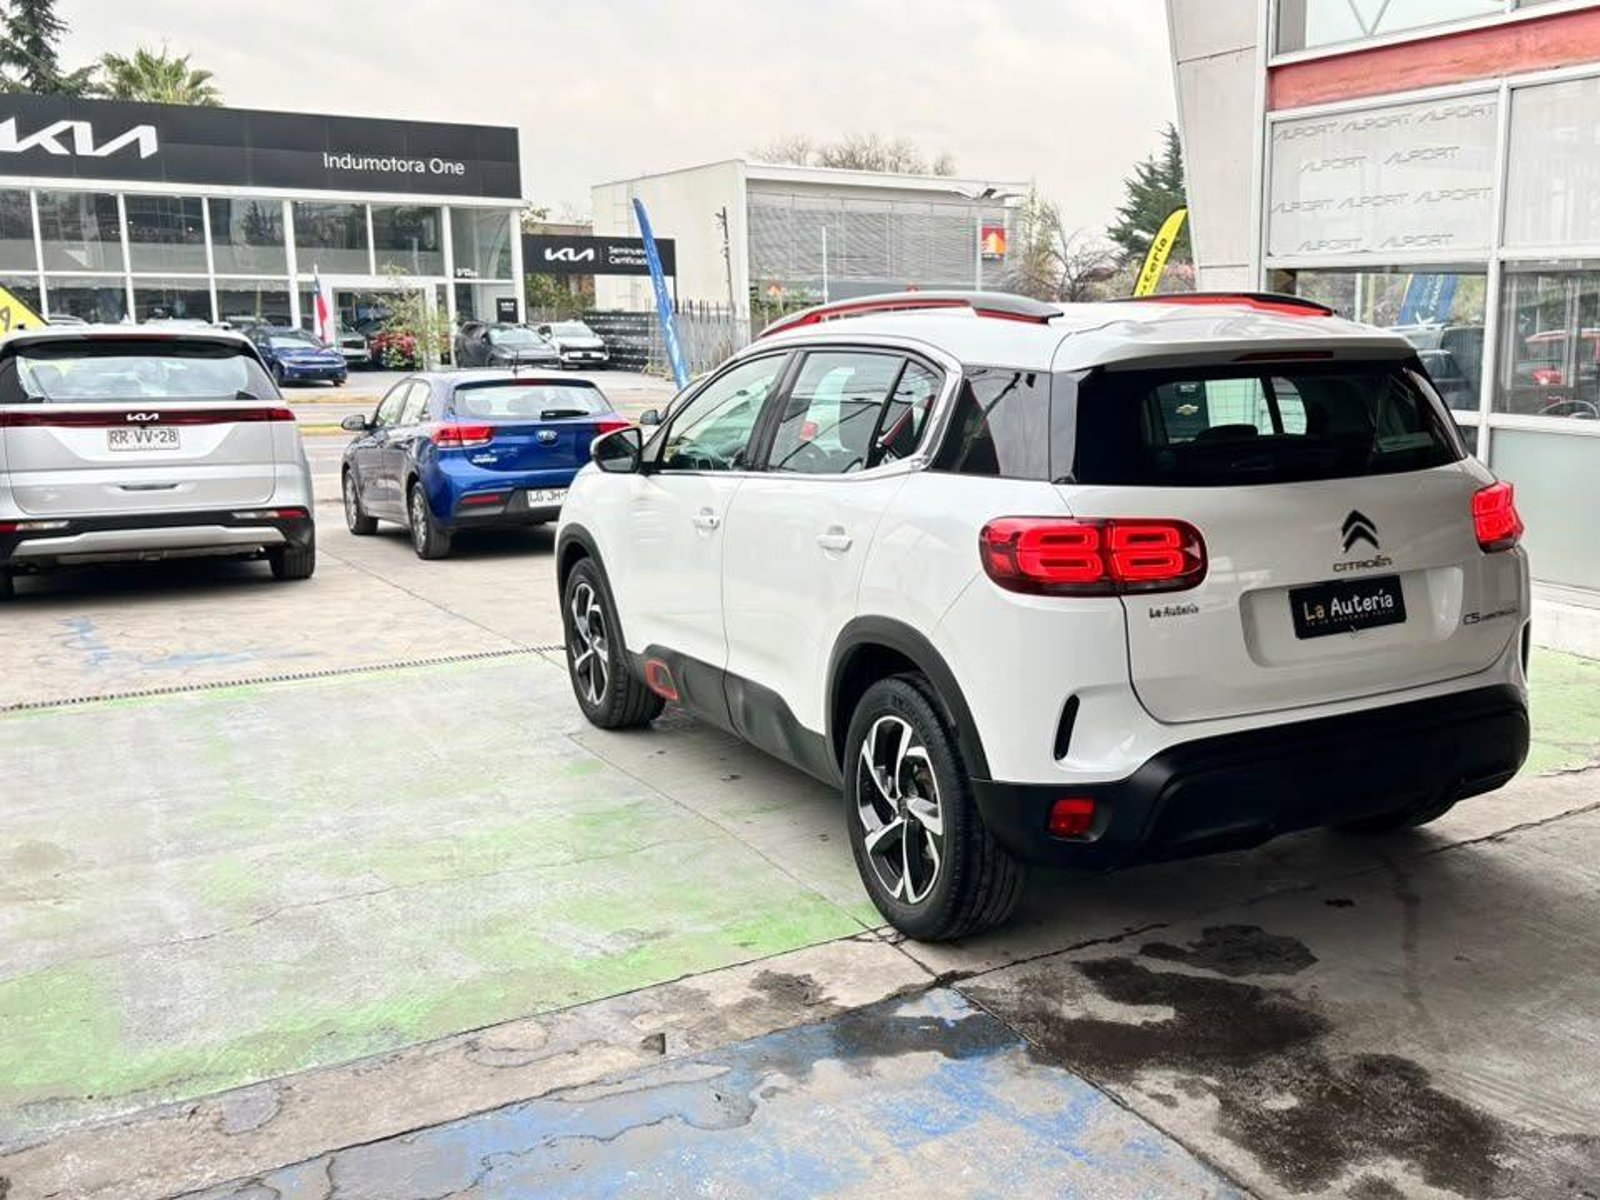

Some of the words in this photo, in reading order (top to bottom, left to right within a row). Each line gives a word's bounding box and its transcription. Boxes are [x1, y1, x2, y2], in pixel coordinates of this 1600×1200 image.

[323, 152, 425, 173] Indumotora
[429, 157, 465, 175] One
[1304, 602, 1325, 621] La
[1330, 589, 1394, 617] Autería
